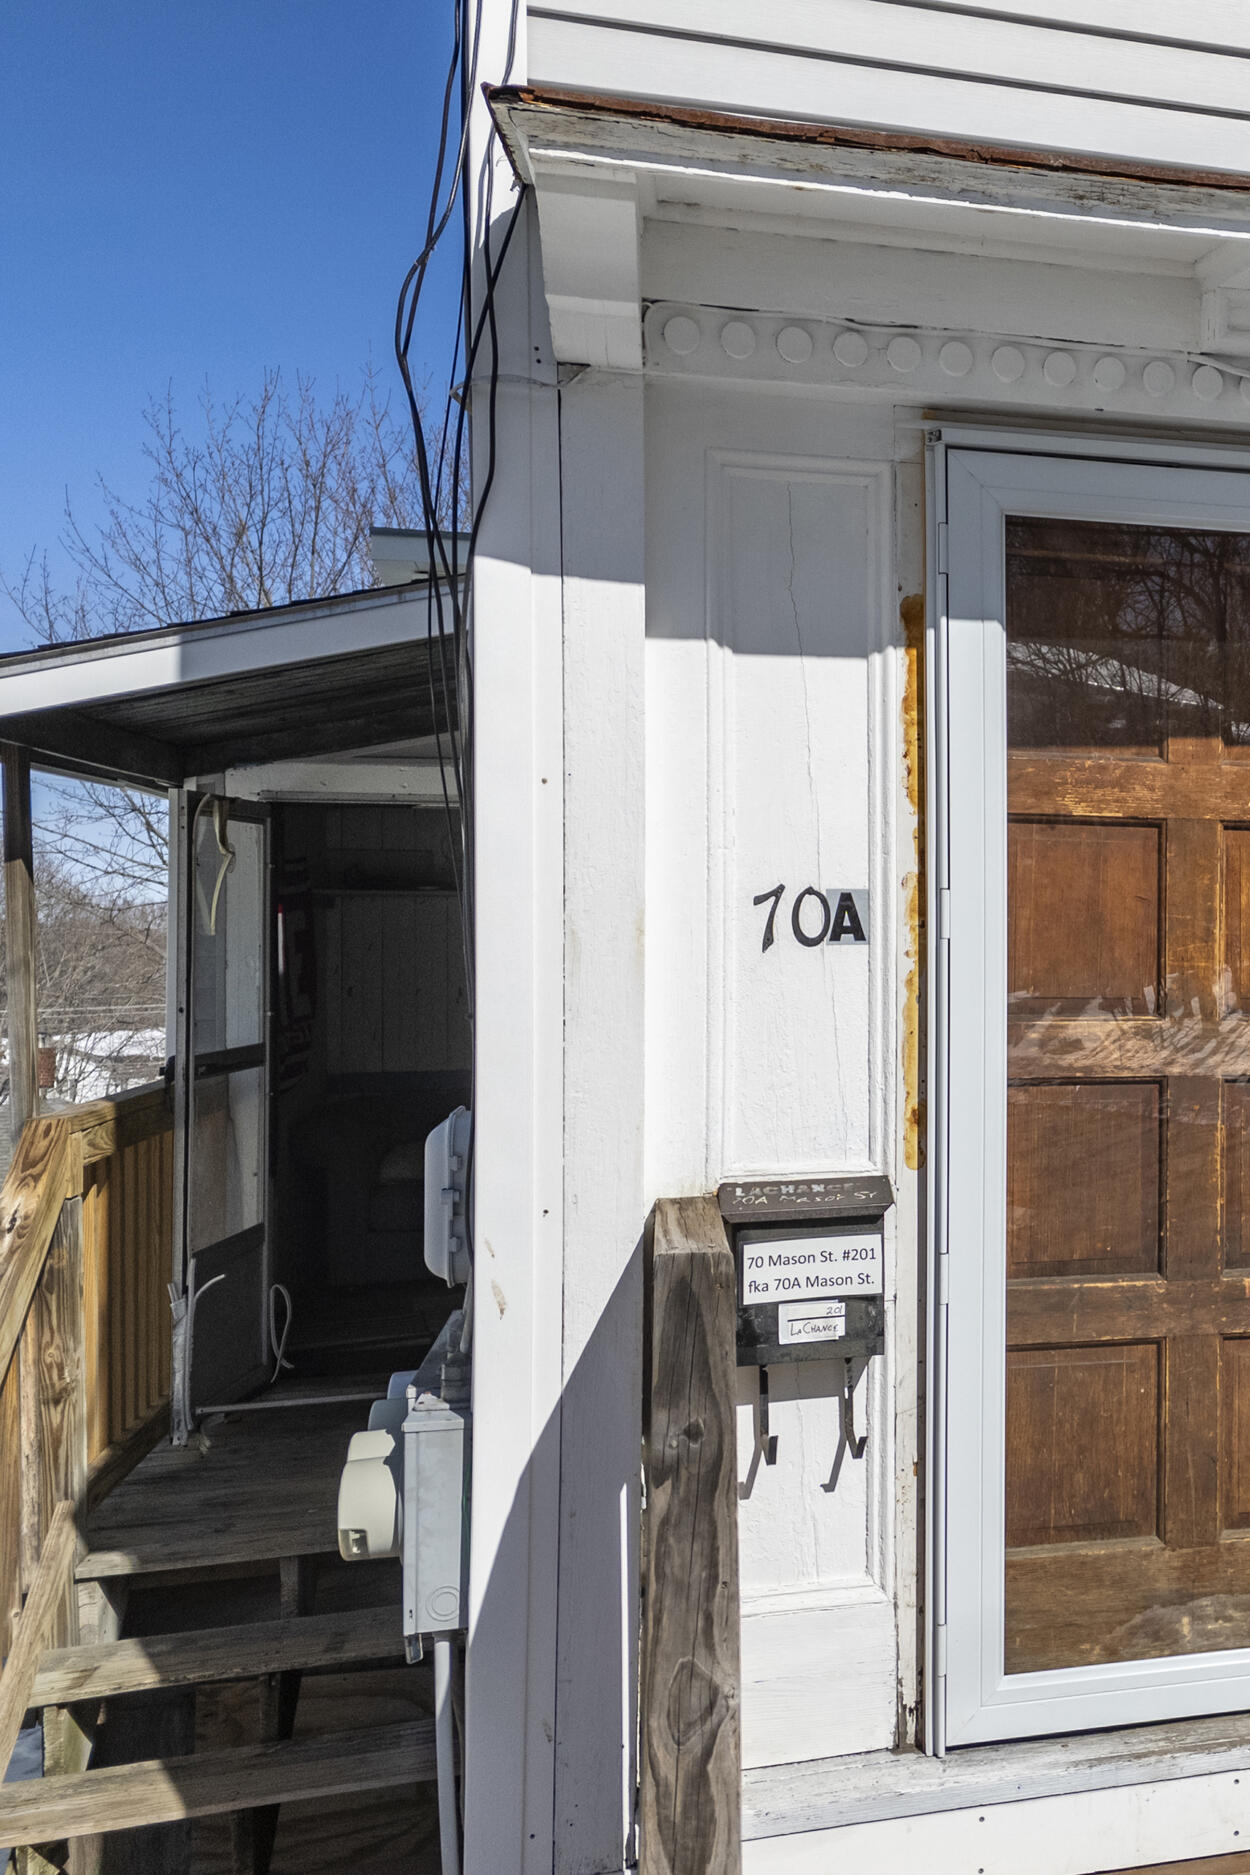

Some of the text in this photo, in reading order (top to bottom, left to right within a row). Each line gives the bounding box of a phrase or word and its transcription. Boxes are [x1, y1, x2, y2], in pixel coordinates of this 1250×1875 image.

[753, 884, 867, 953] 70A
[747, 1248, 876, 1269] 70 Mason St. #201
[748, 1272, 875, 1293] fka 70A Mason St.
[826, 1305, 843, 1315] 201
